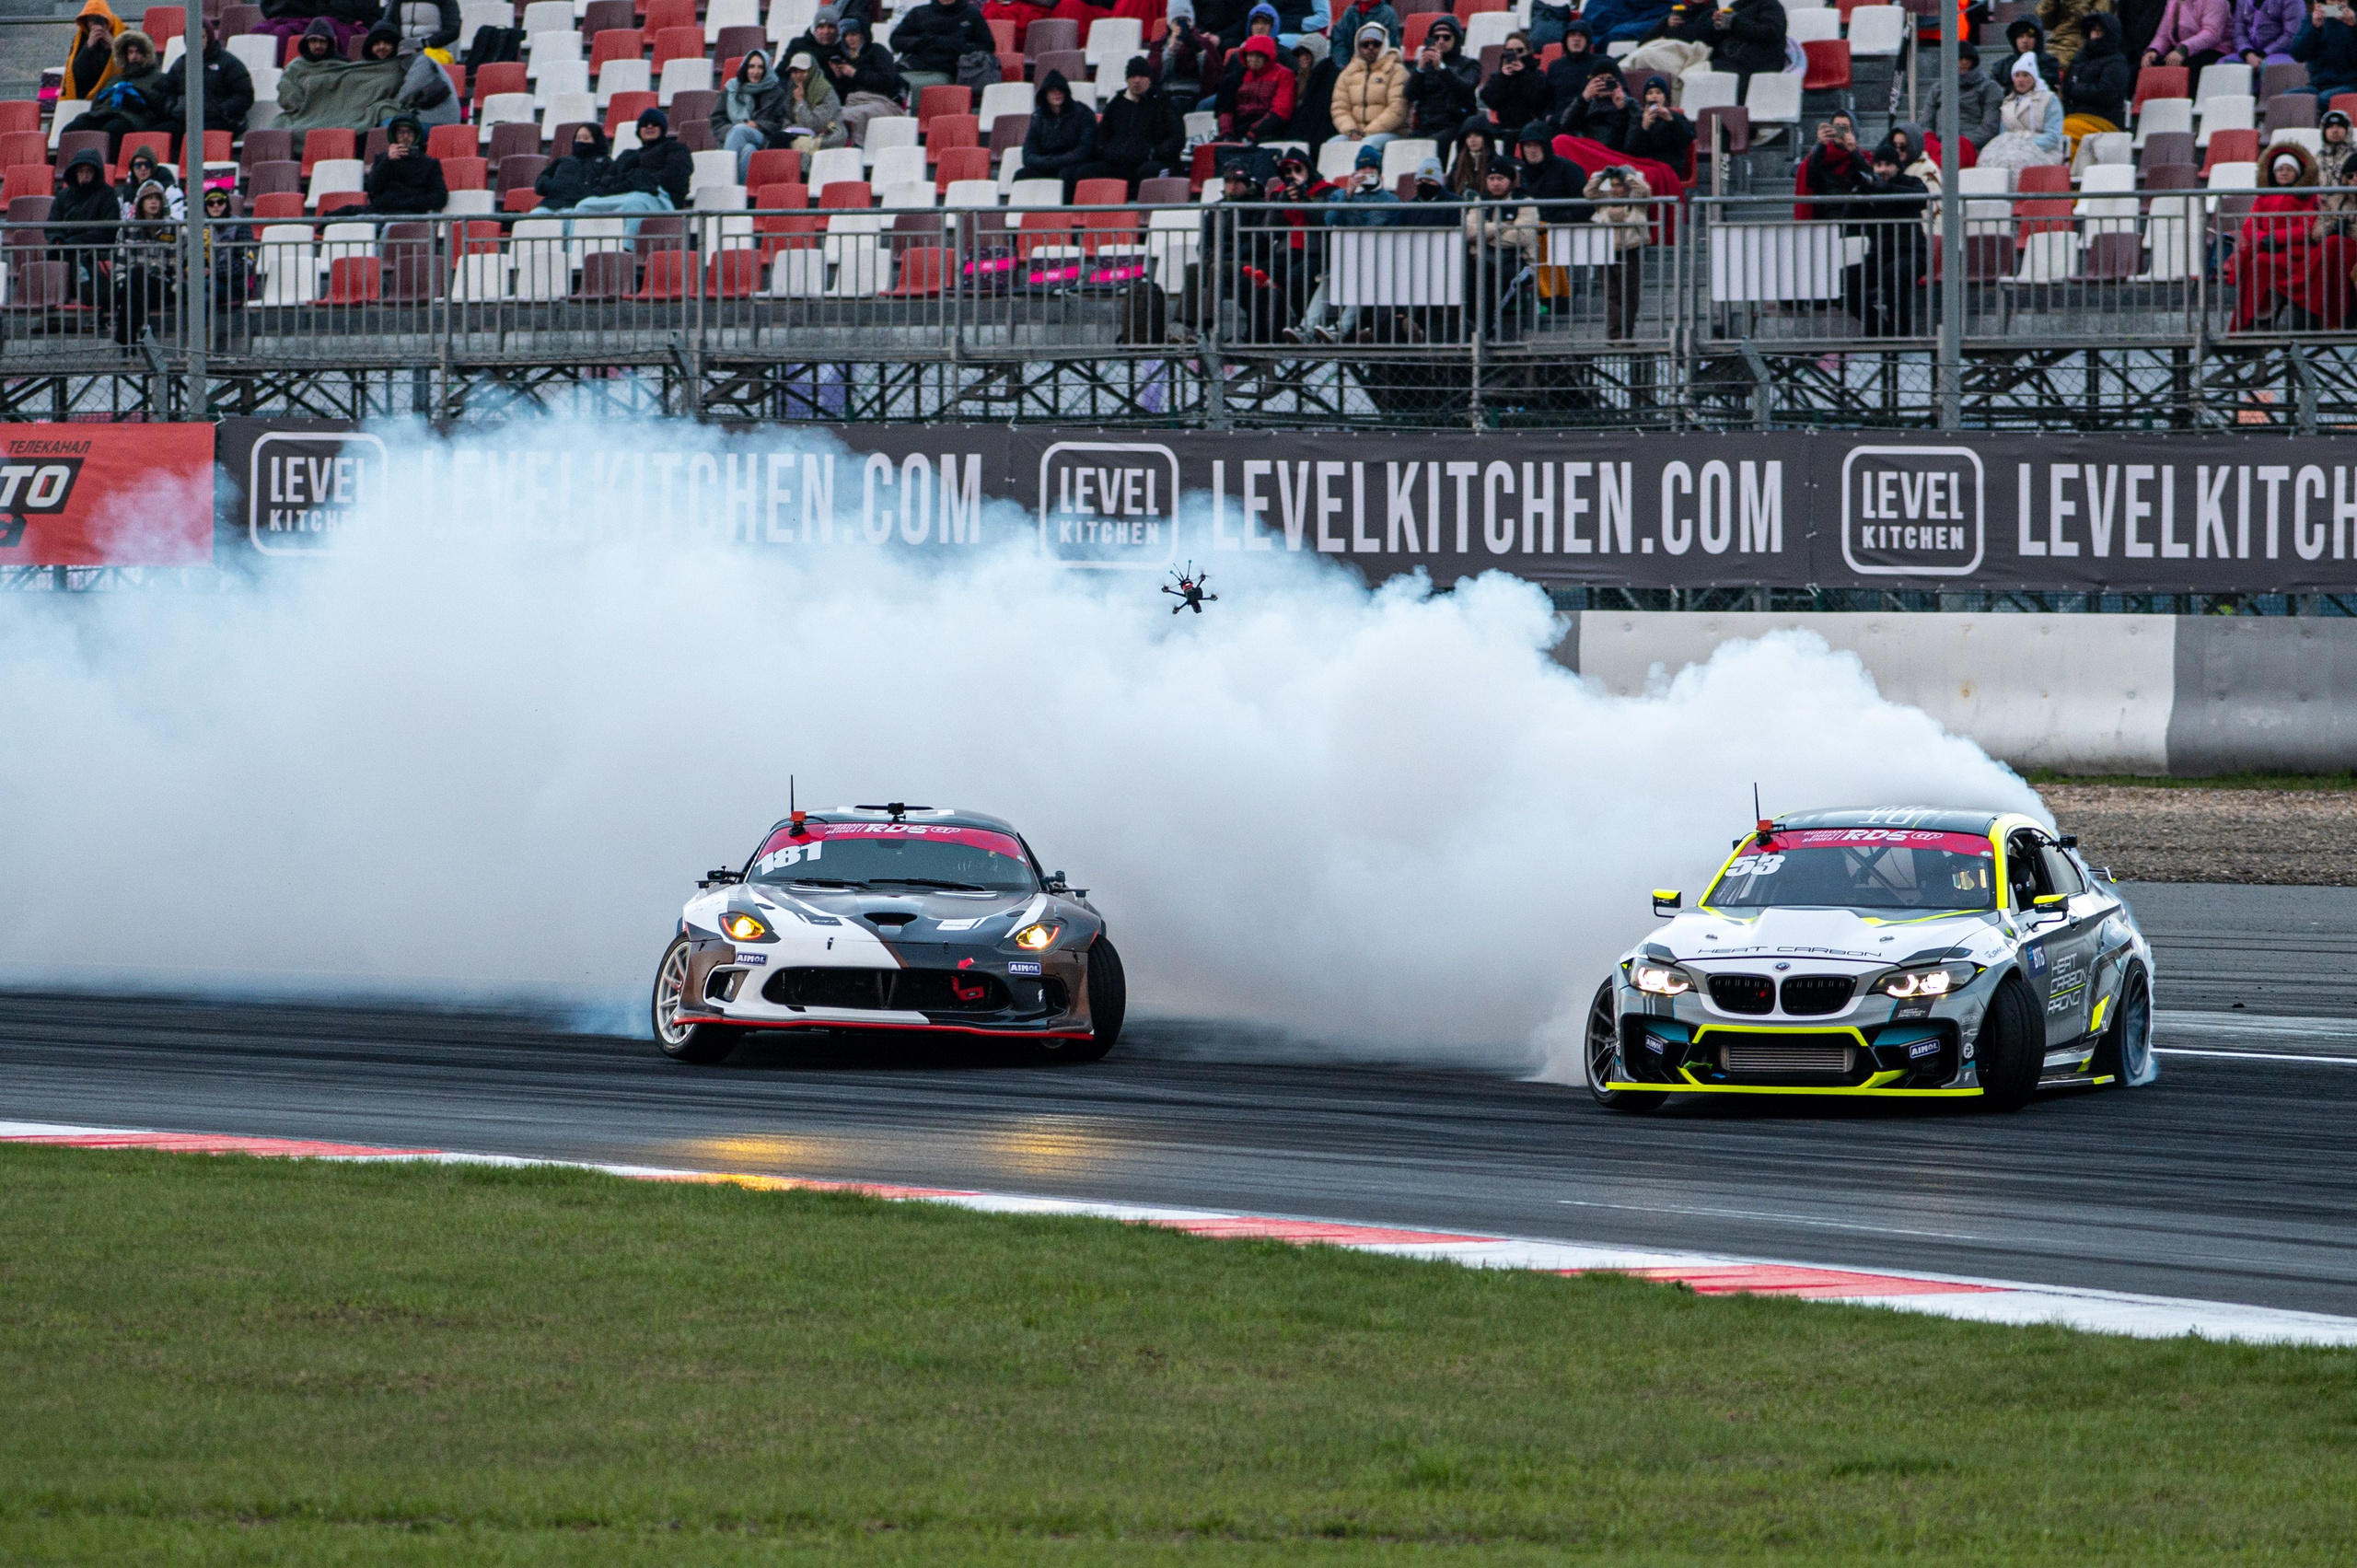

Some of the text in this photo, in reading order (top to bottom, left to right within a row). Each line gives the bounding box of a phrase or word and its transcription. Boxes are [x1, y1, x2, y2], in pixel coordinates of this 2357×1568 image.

[8, 440, 92, 454] ТЕЛЕКАНАЛ
[270, 456, 366, 503] LEVEL
[1060, 467, 1159, 515] LEVEL
[1212, 459, 1782, 554] LEVELKITCHEN.COM
[1862, 470, 1964, 519] LEVEL
[2018, 462, 2357, 561] LEVELKITCH
[1059, 520, 1159, 545] KITCHEN
[1862, 525, 1965, 550] KITCHEN
[864, 822, 935, 834] RDS
[1841, 830, 1915, 842] RDS
[755, 841, 823, 876] 181
[1724, 854, 1786, 877] 53
[737, 953, 766, 964] AIMOL
[1698, 946, 1882, 958] HEAT CARBON
[2031, 946, 2046, 969] ВТБ
[2051, 952, 2078, 977] HEAT
[1010, 963, 1040, 973] AIMOL
[2049, 968, 2087, 994] CARBON
[1911, 1042, 1939, 1056] AIMOL
